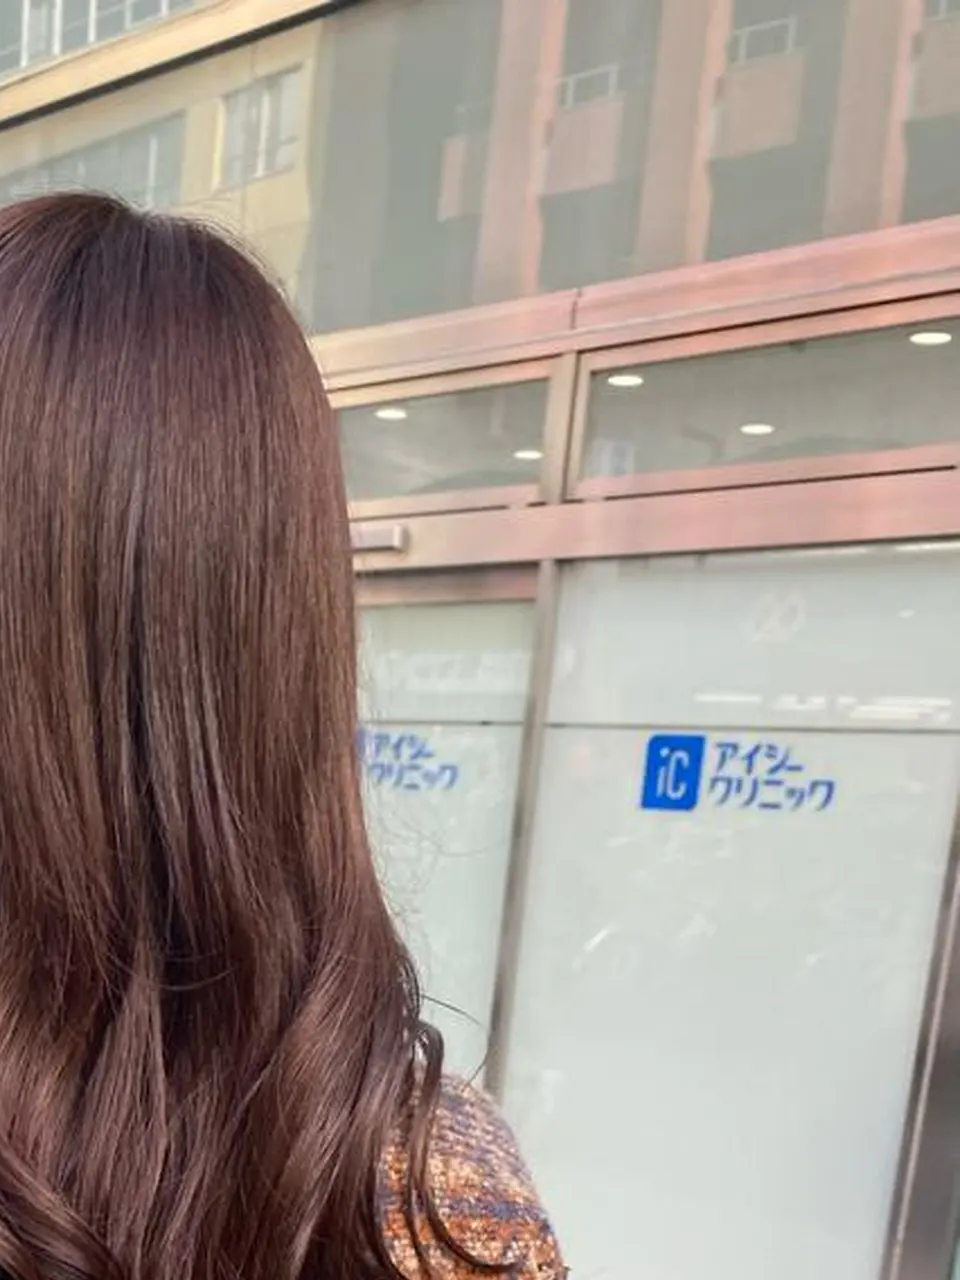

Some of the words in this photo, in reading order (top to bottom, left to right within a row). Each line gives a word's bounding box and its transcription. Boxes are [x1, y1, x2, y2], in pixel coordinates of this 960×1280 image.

[715, 742, 804, 775] アイシー
[709, 776, 836, 811] クリニック
